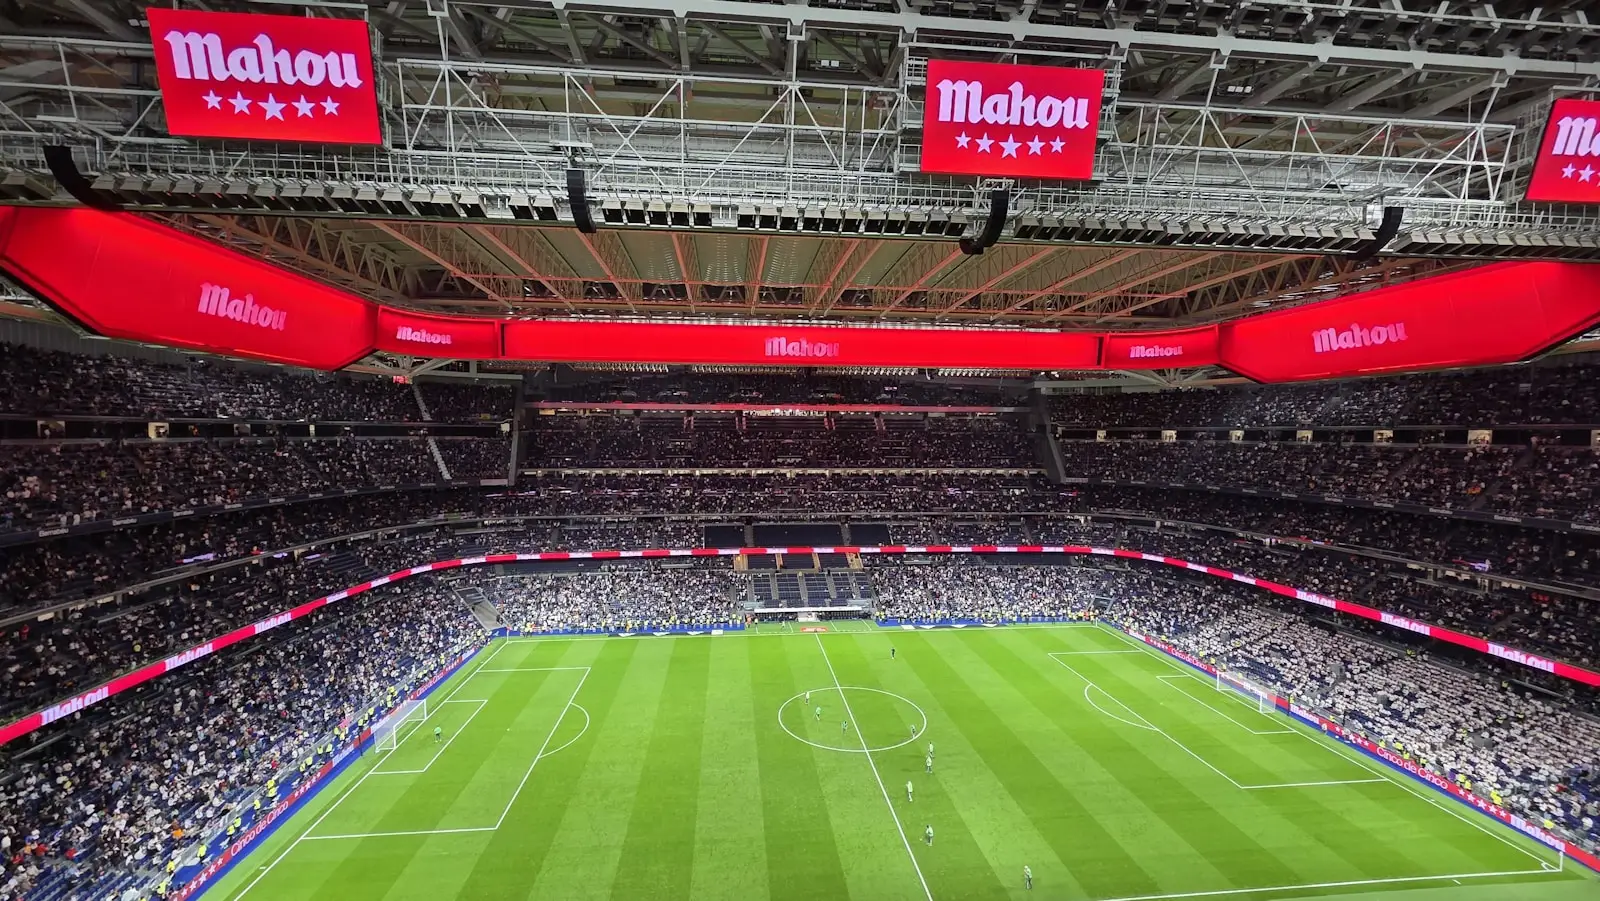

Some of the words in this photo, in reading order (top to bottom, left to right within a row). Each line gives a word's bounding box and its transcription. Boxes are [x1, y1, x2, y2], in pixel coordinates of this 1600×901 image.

[164, 30, 363, 89] Mahou
[936, 79, 1089, 129] Mahou
[198, 282, 287, 331] Mahou
[396, 316, 452, 345] Mahou
[1312, 322, 1408, 353] Mahou
[765, 336, 839, 357] Mahou
[1130, 344, 1183, 358] Mahou
[1376, 746, 1403, 767] Cinco
[1403, 760, 1417, 774] de
[1418, 767, 1448, 790] Cinco
[255, 820, 267, 835] de
